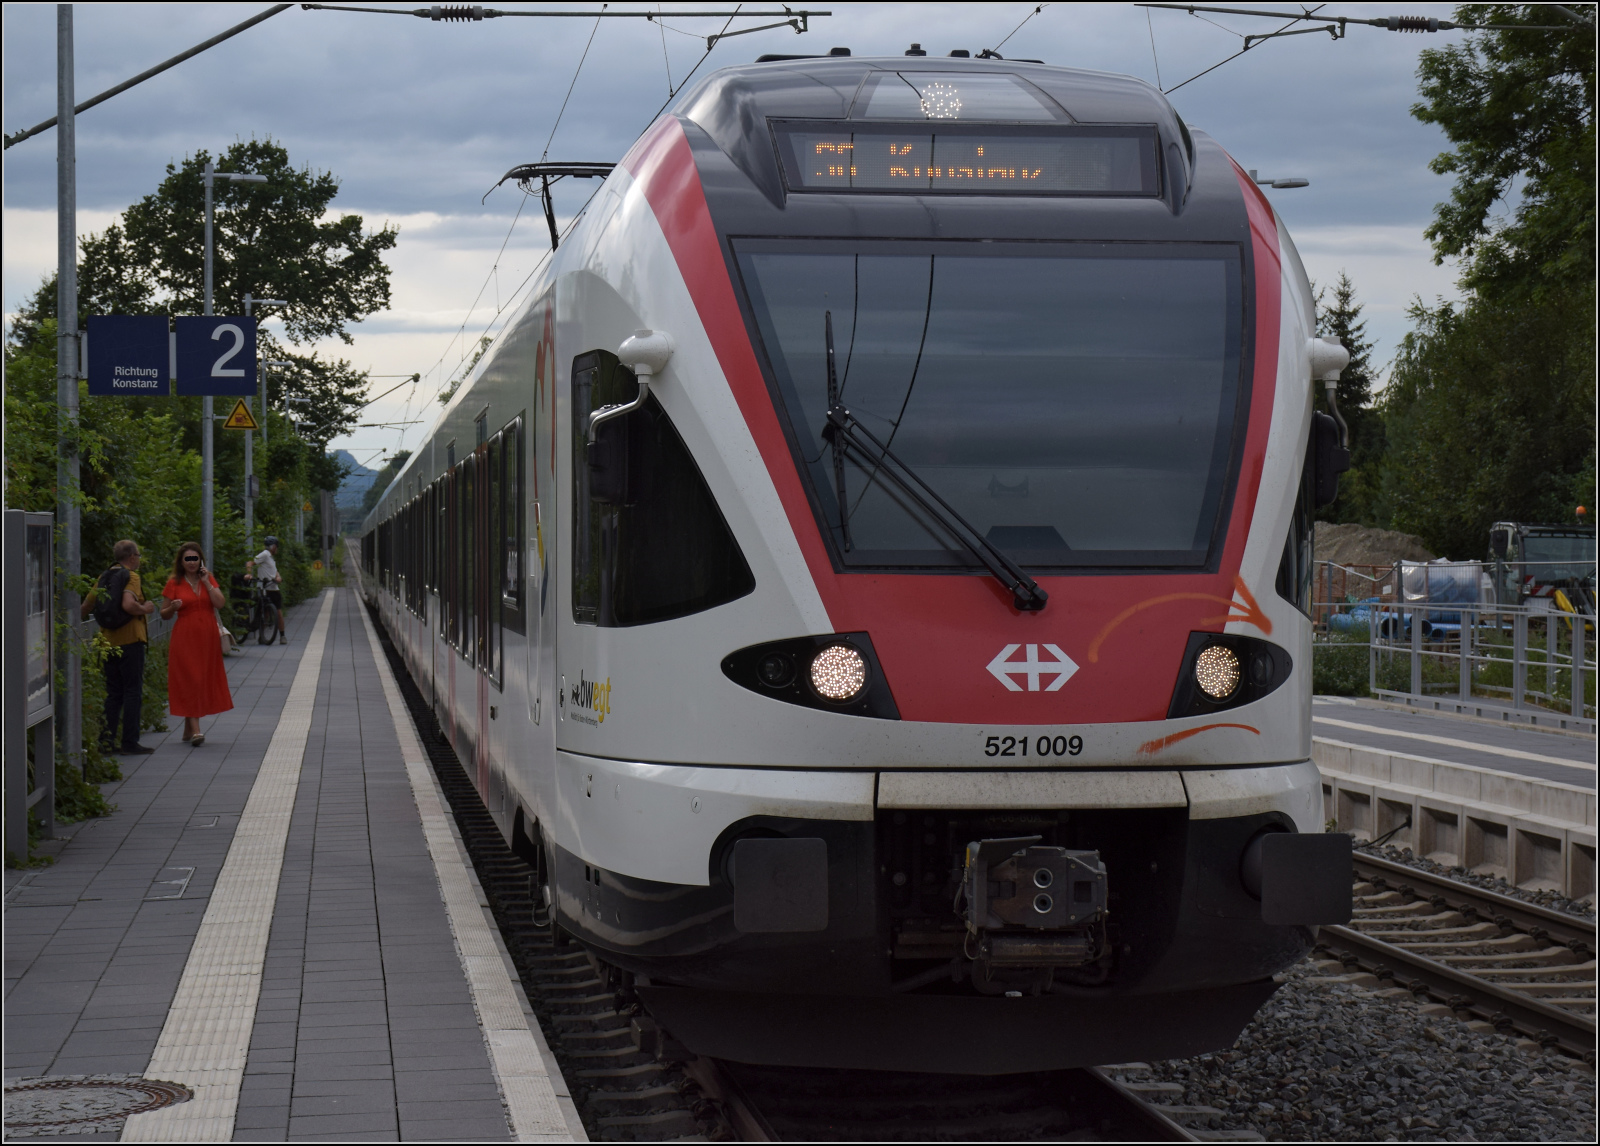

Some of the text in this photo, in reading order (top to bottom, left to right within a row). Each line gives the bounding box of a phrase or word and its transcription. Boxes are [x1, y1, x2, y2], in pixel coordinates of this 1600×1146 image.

[210, 323, 246, 377] 2
[112, 378, 158, 388] Konstanz
[114, 366, 158, 378] Richtung
[580, 668, 612, 723] bwegt
[984, 735, 1083, 757] 521 009
